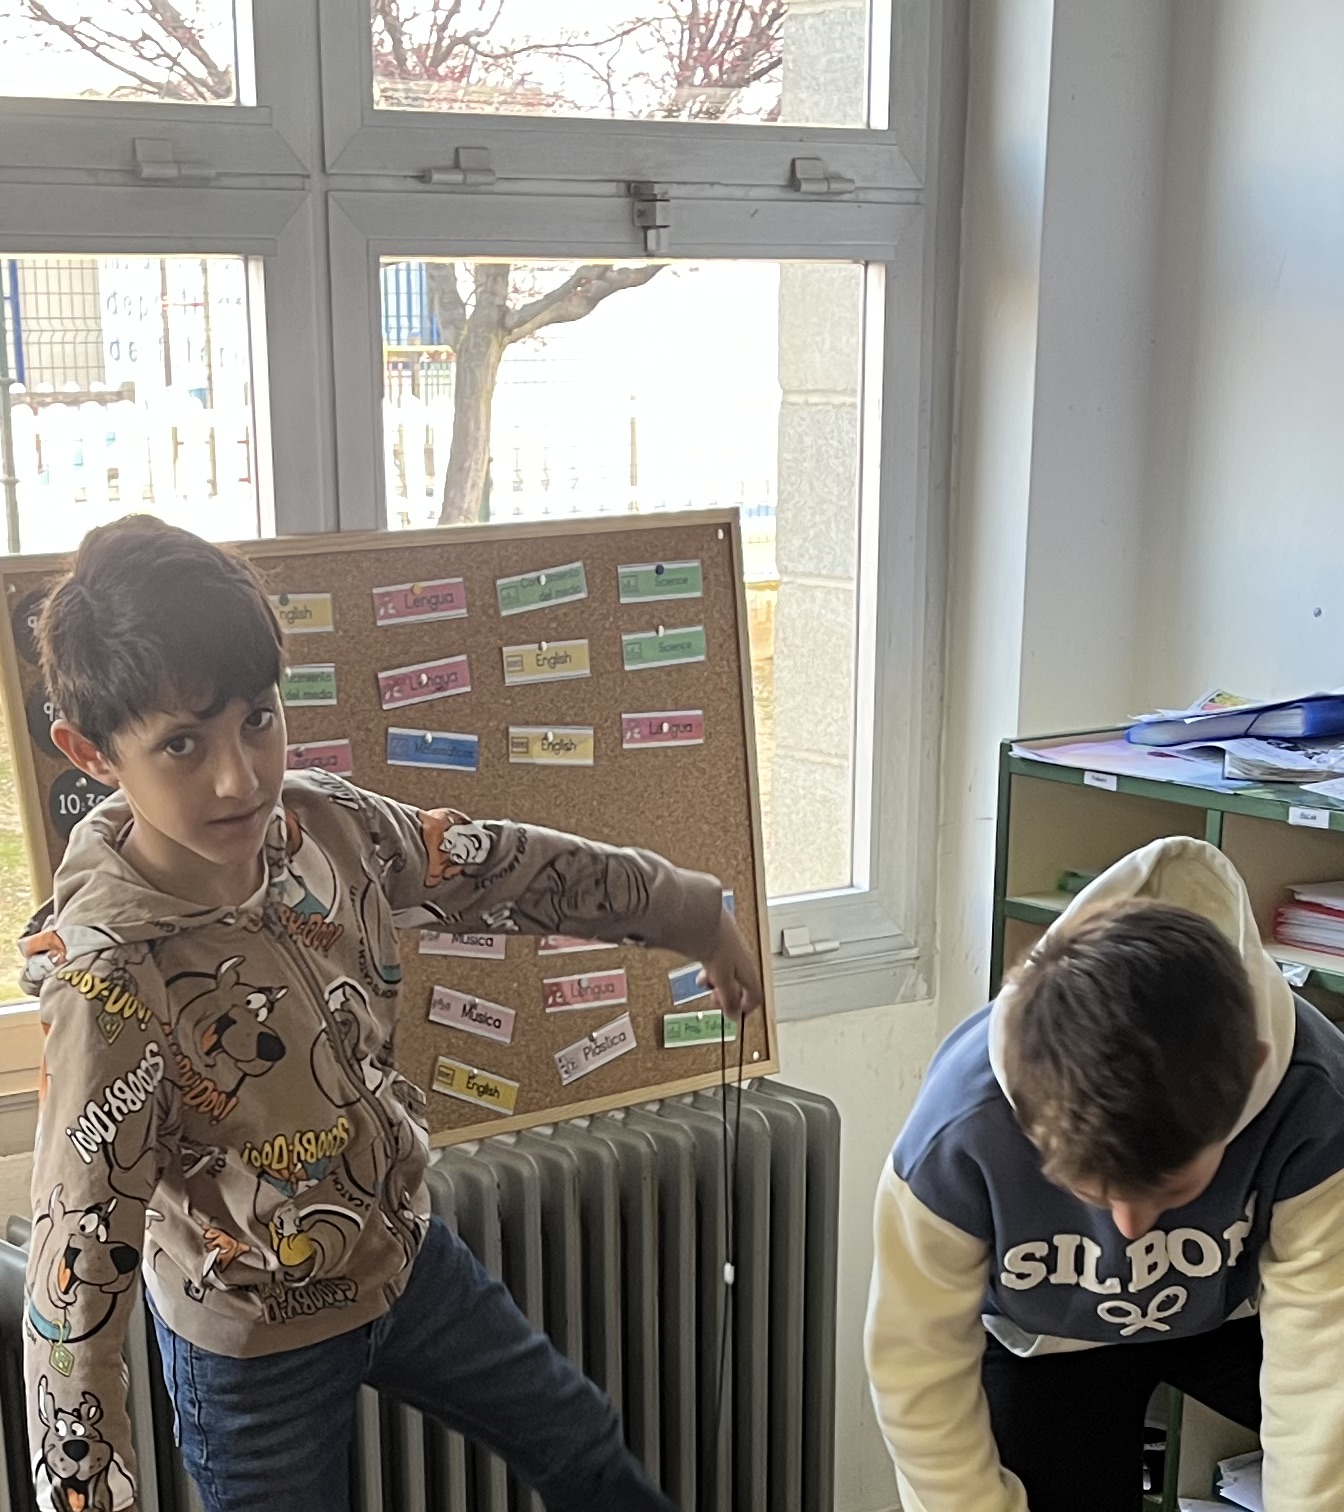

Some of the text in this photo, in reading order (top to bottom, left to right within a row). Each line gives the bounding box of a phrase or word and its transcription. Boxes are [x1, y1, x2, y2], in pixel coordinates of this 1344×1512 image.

[404, 590, 455, 611] Lengua
[277, 605, 312, 625] nglish
[535, 650, 573, 670] English
[409, 669, 458, 692] Lngua
[540, 736, 577, 756] English
[465, 1075, 501, 1099] English
